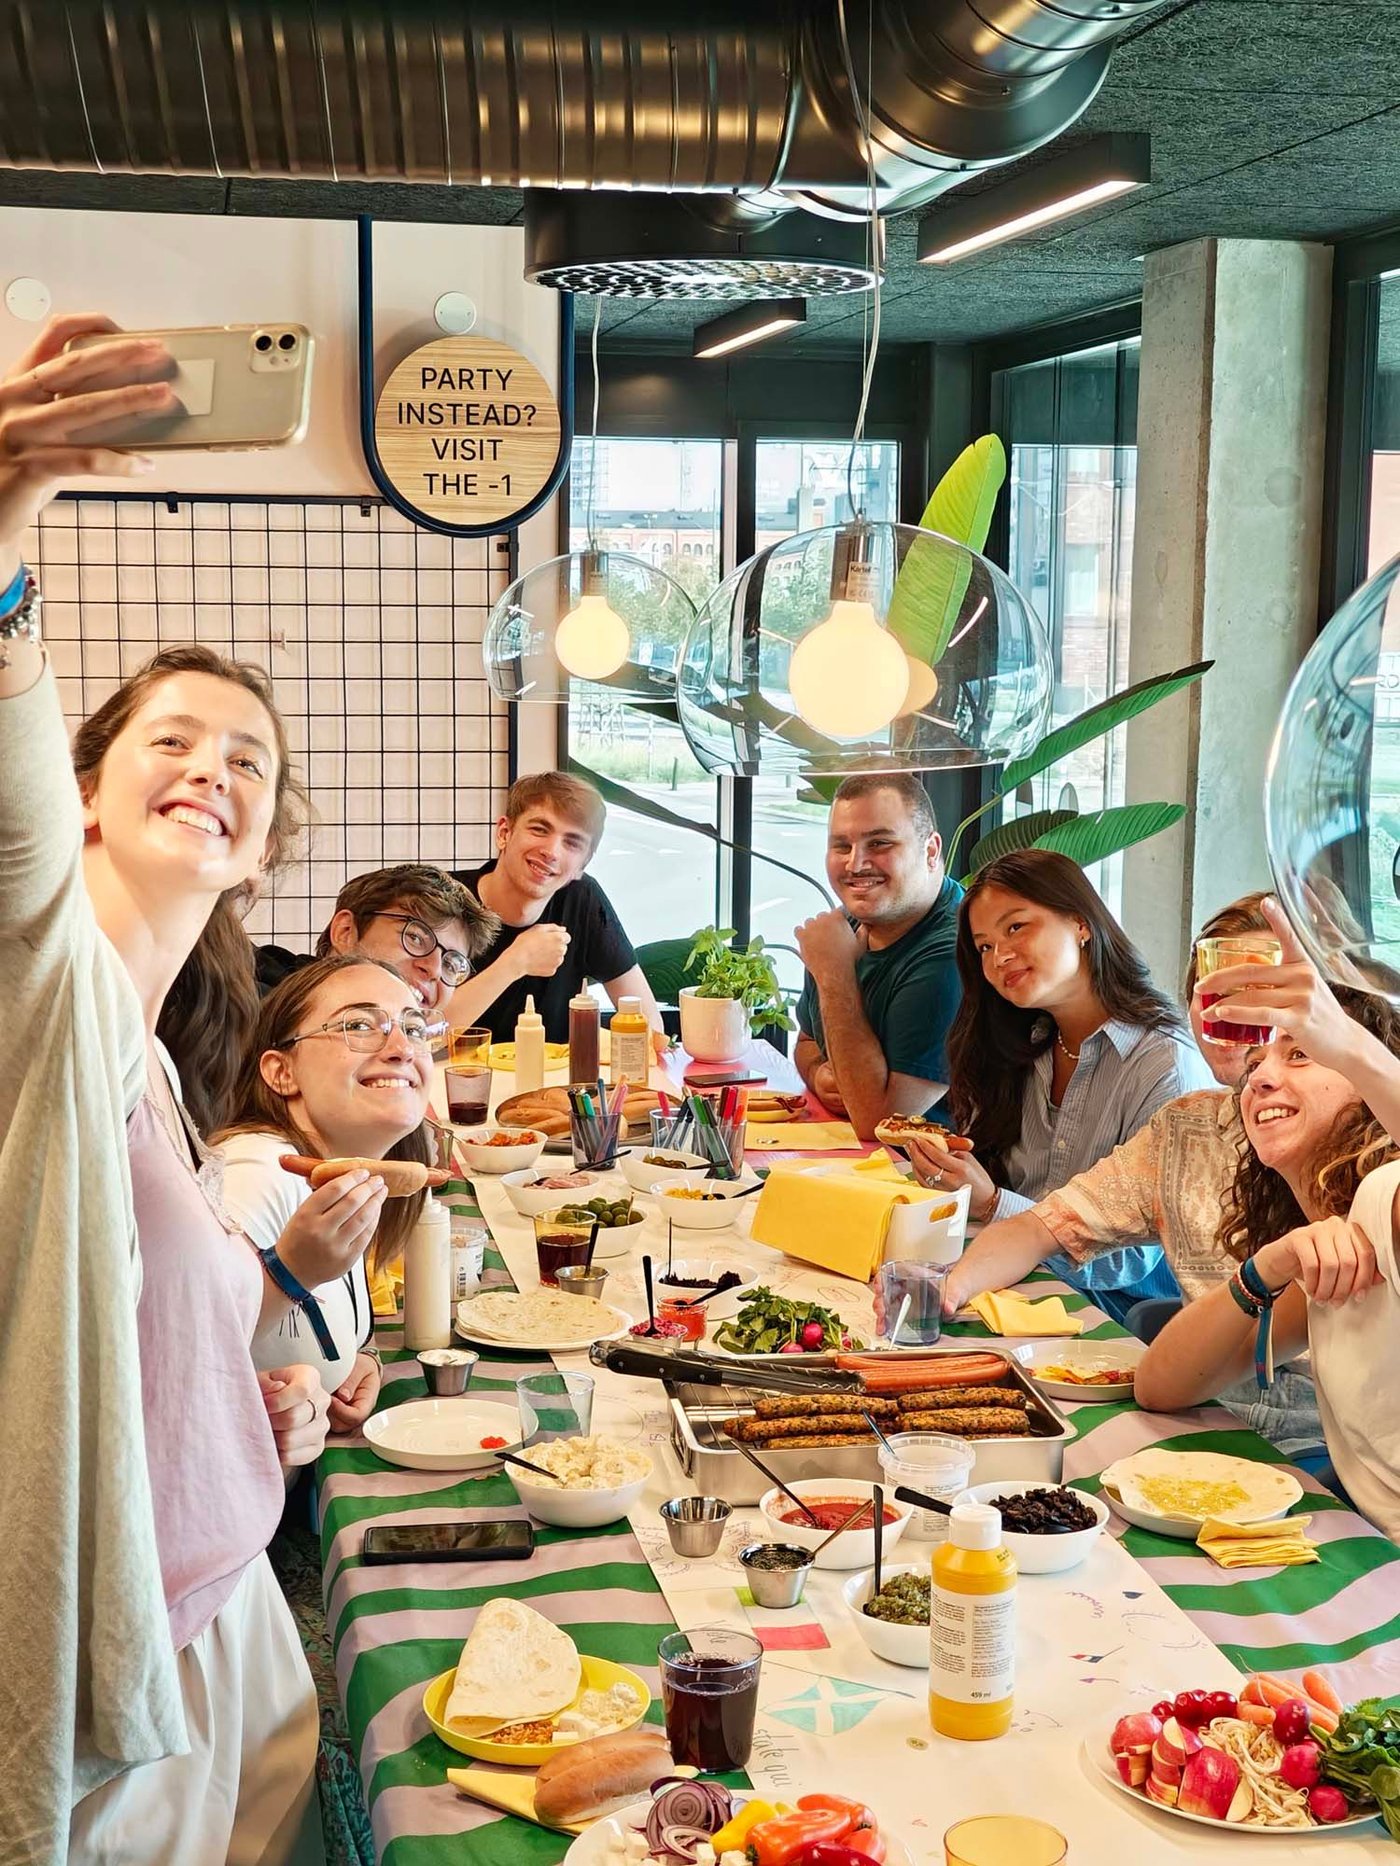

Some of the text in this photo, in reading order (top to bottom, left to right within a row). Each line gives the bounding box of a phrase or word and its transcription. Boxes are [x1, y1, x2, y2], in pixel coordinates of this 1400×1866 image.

[421, 367, 513, 391] PARTY
[398, 402, 537, 427] INSTEAD?
[431, 438, 504, 461] VISIT
[423, 473, 512, 496] THE -1
